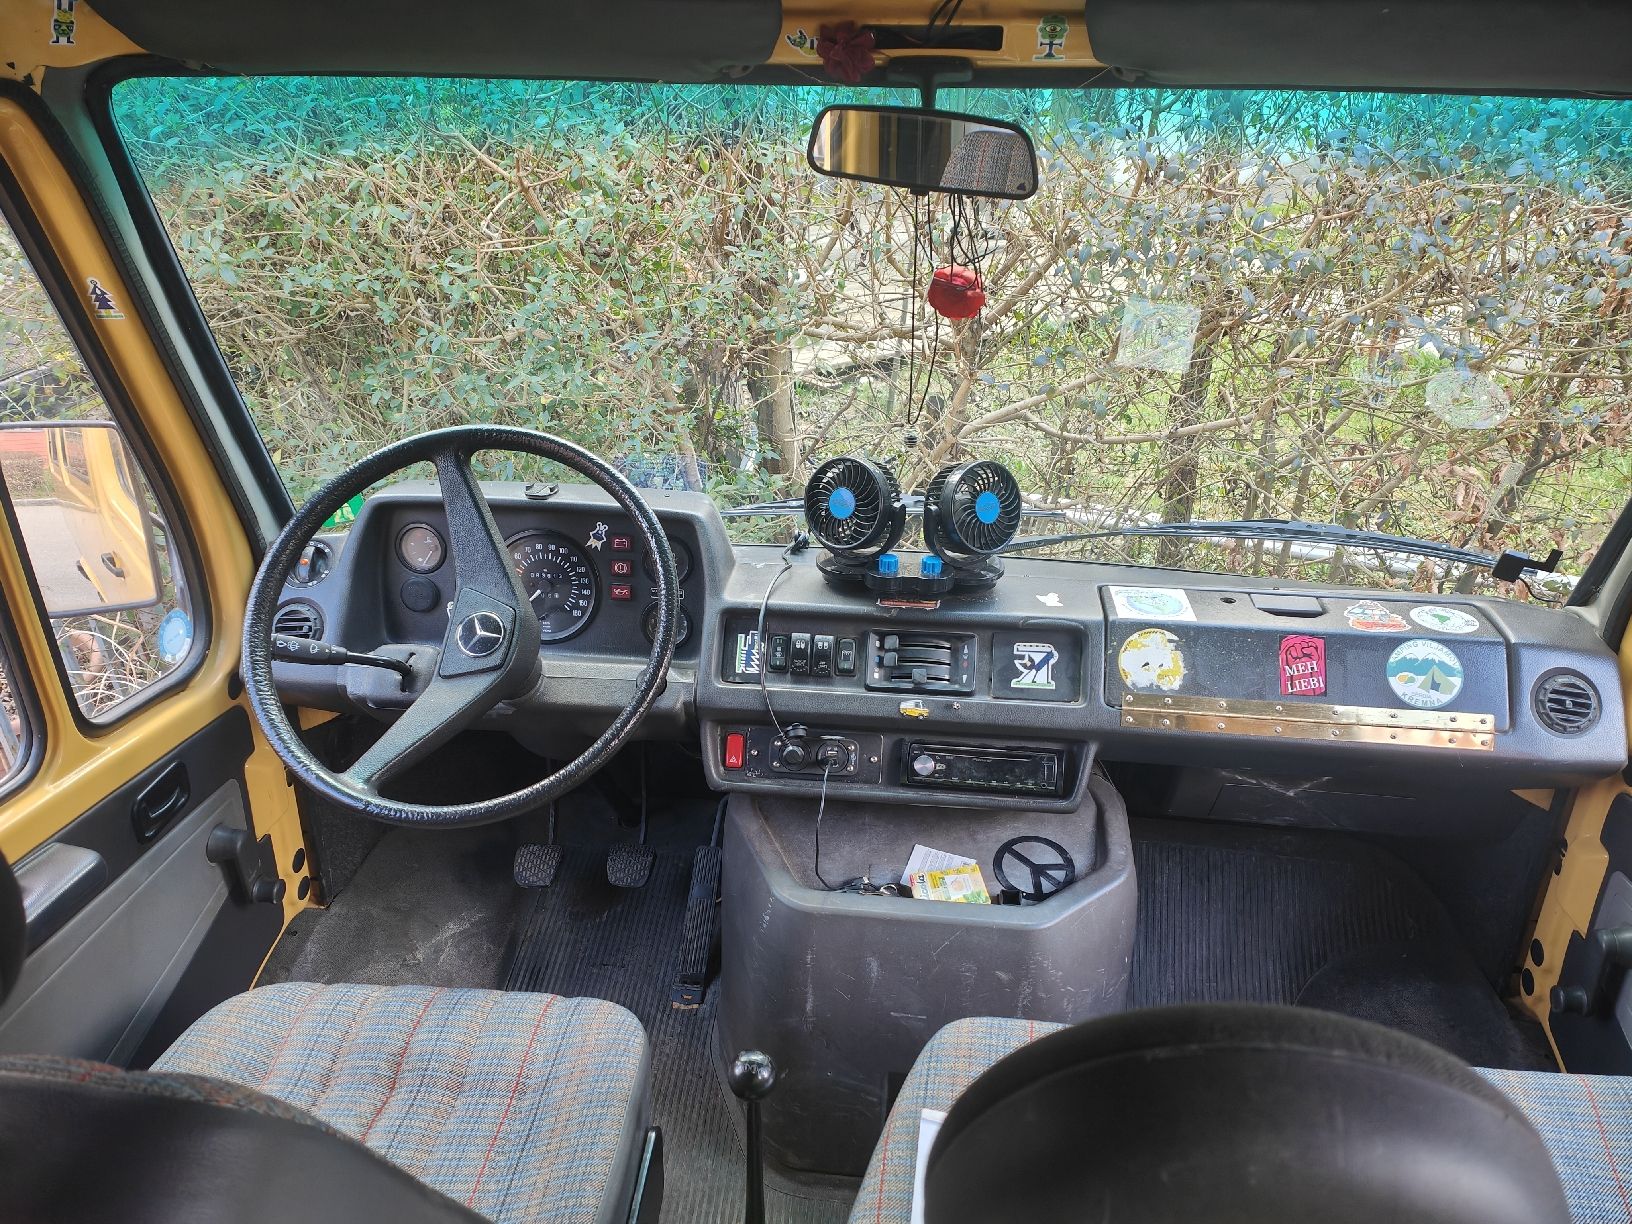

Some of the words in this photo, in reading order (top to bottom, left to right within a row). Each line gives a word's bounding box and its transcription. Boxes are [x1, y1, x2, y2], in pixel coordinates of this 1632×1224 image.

[1390, 641, 1419, 666] AMPING
[1284, 660, 1319, 677] MEH
[1401, 692, 1444, 707] KREMNA
